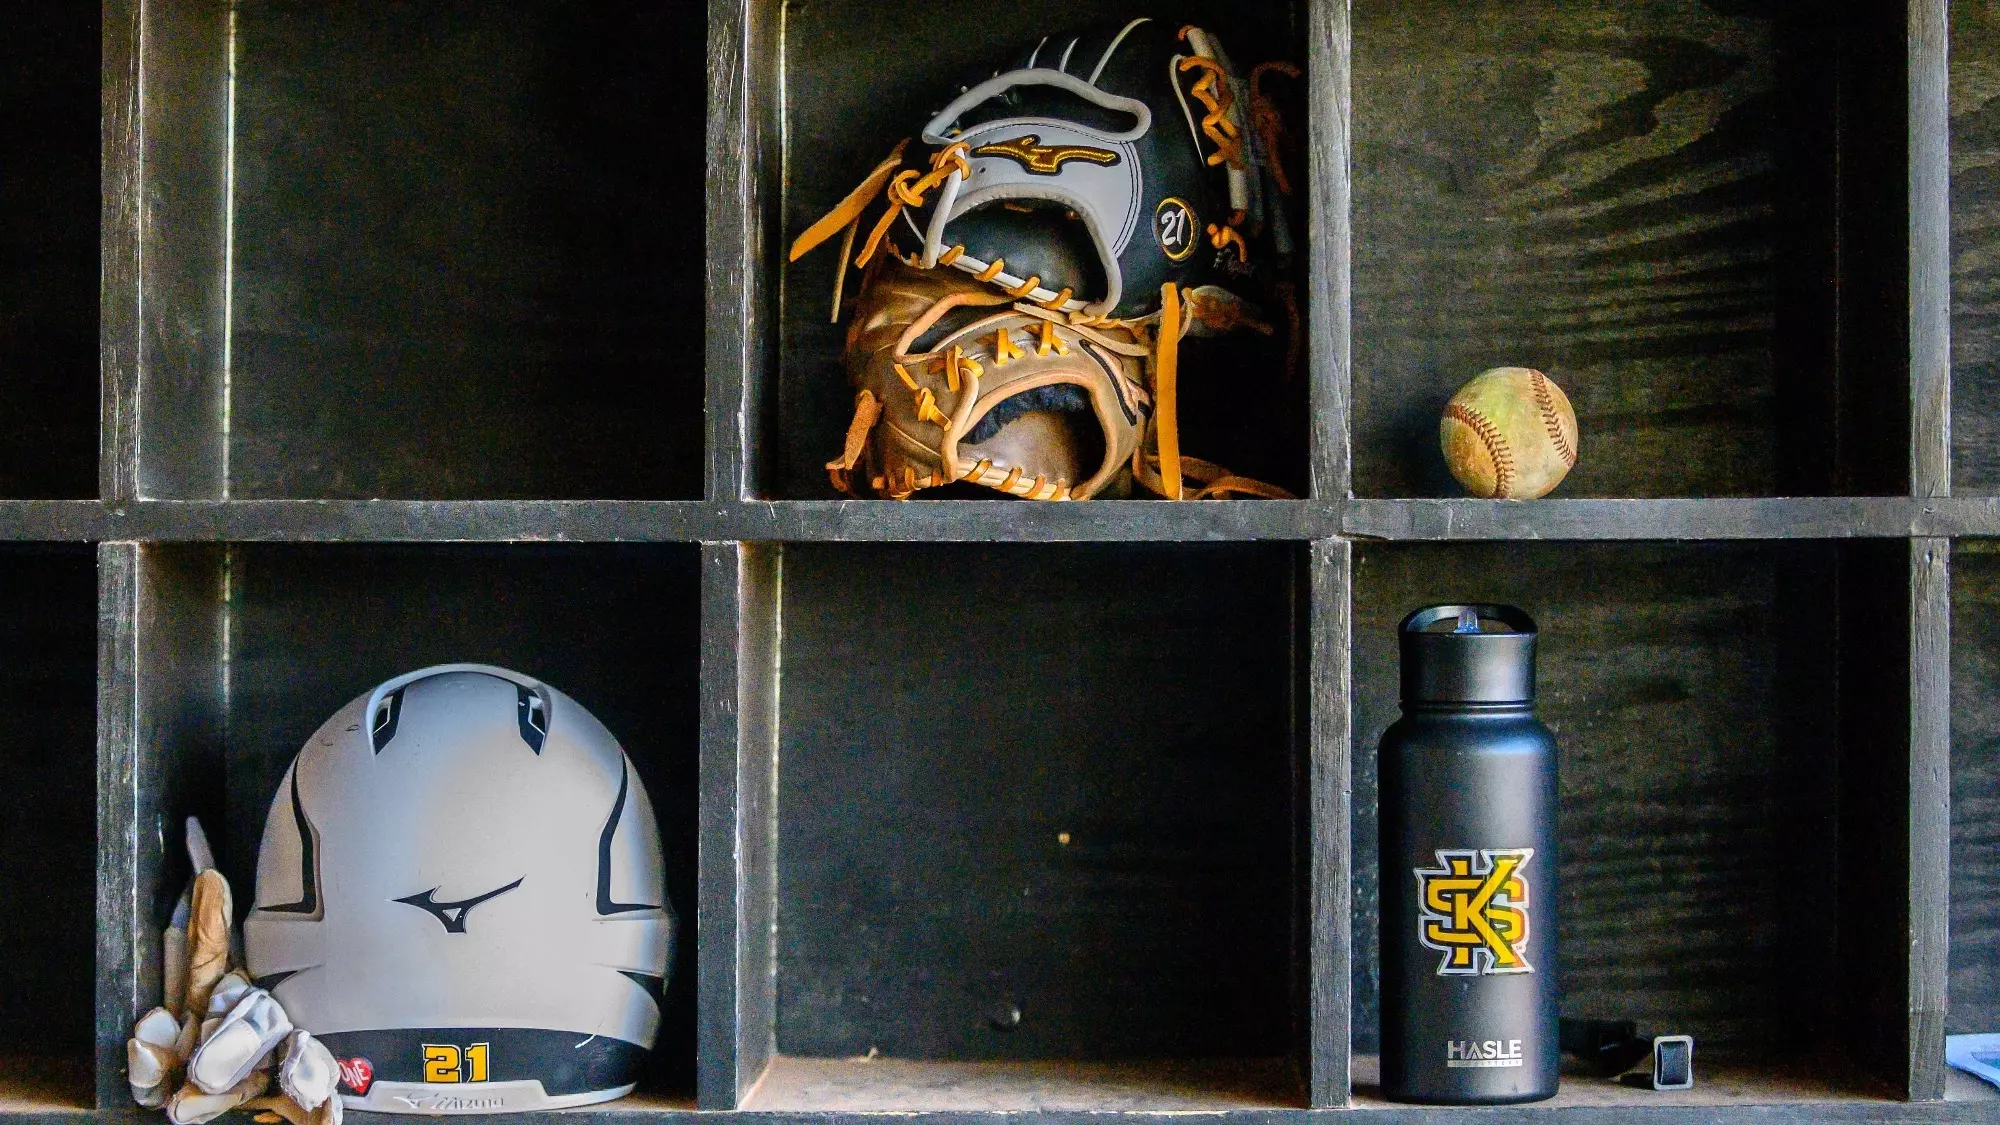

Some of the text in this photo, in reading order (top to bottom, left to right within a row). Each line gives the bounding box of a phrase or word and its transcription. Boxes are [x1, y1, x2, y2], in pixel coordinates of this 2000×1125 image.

[1161, 208, 1186, 246] 21
[422, 1042, 489, 1083] 21
[1447, 1039, 1522, 1060] HASLE
